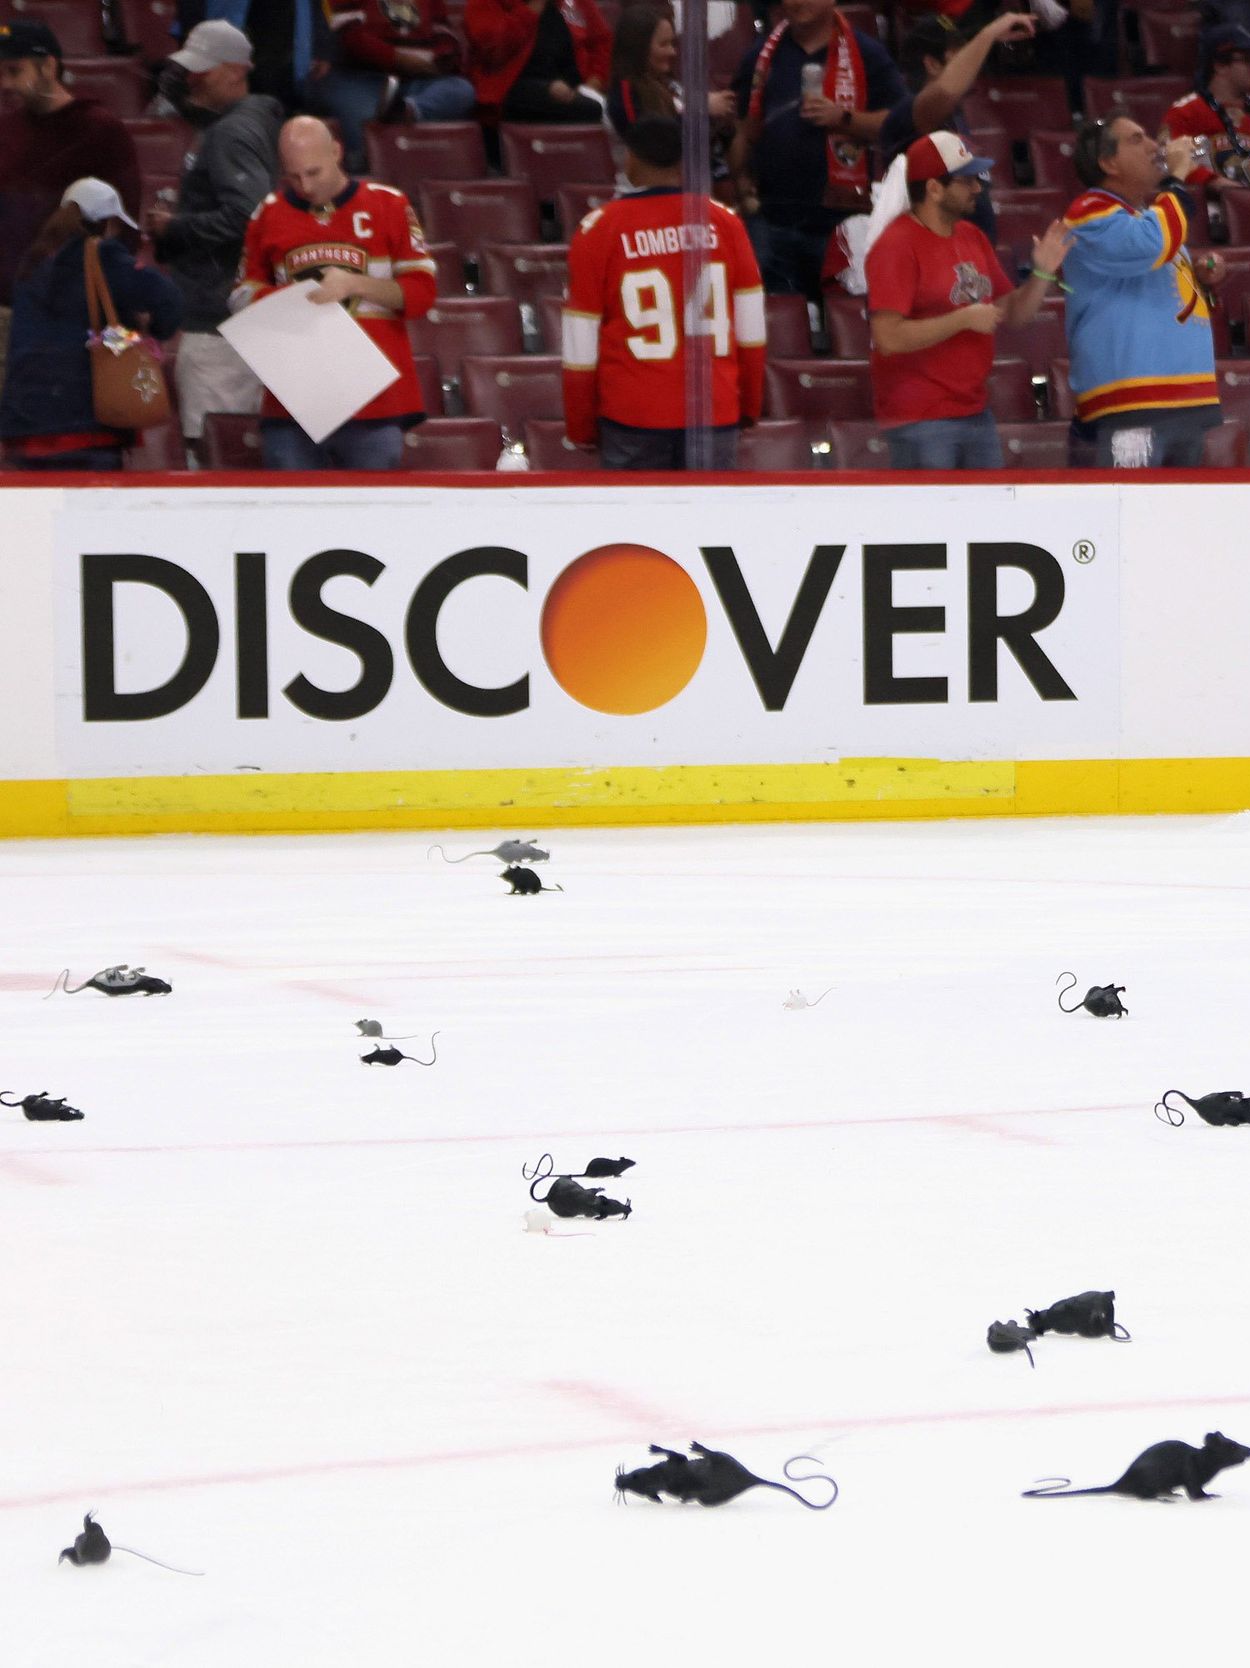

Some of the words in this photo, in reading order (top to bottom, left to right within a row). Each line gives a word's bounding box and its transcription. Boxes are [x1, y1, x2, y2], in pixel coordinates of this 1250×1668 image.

[291, 248, 360, 265] PANTHERS
[352, 211, 374, 239] C
[621, 262, 730, 360] 94
[81, 542, 1078, 722] DISCOVER
